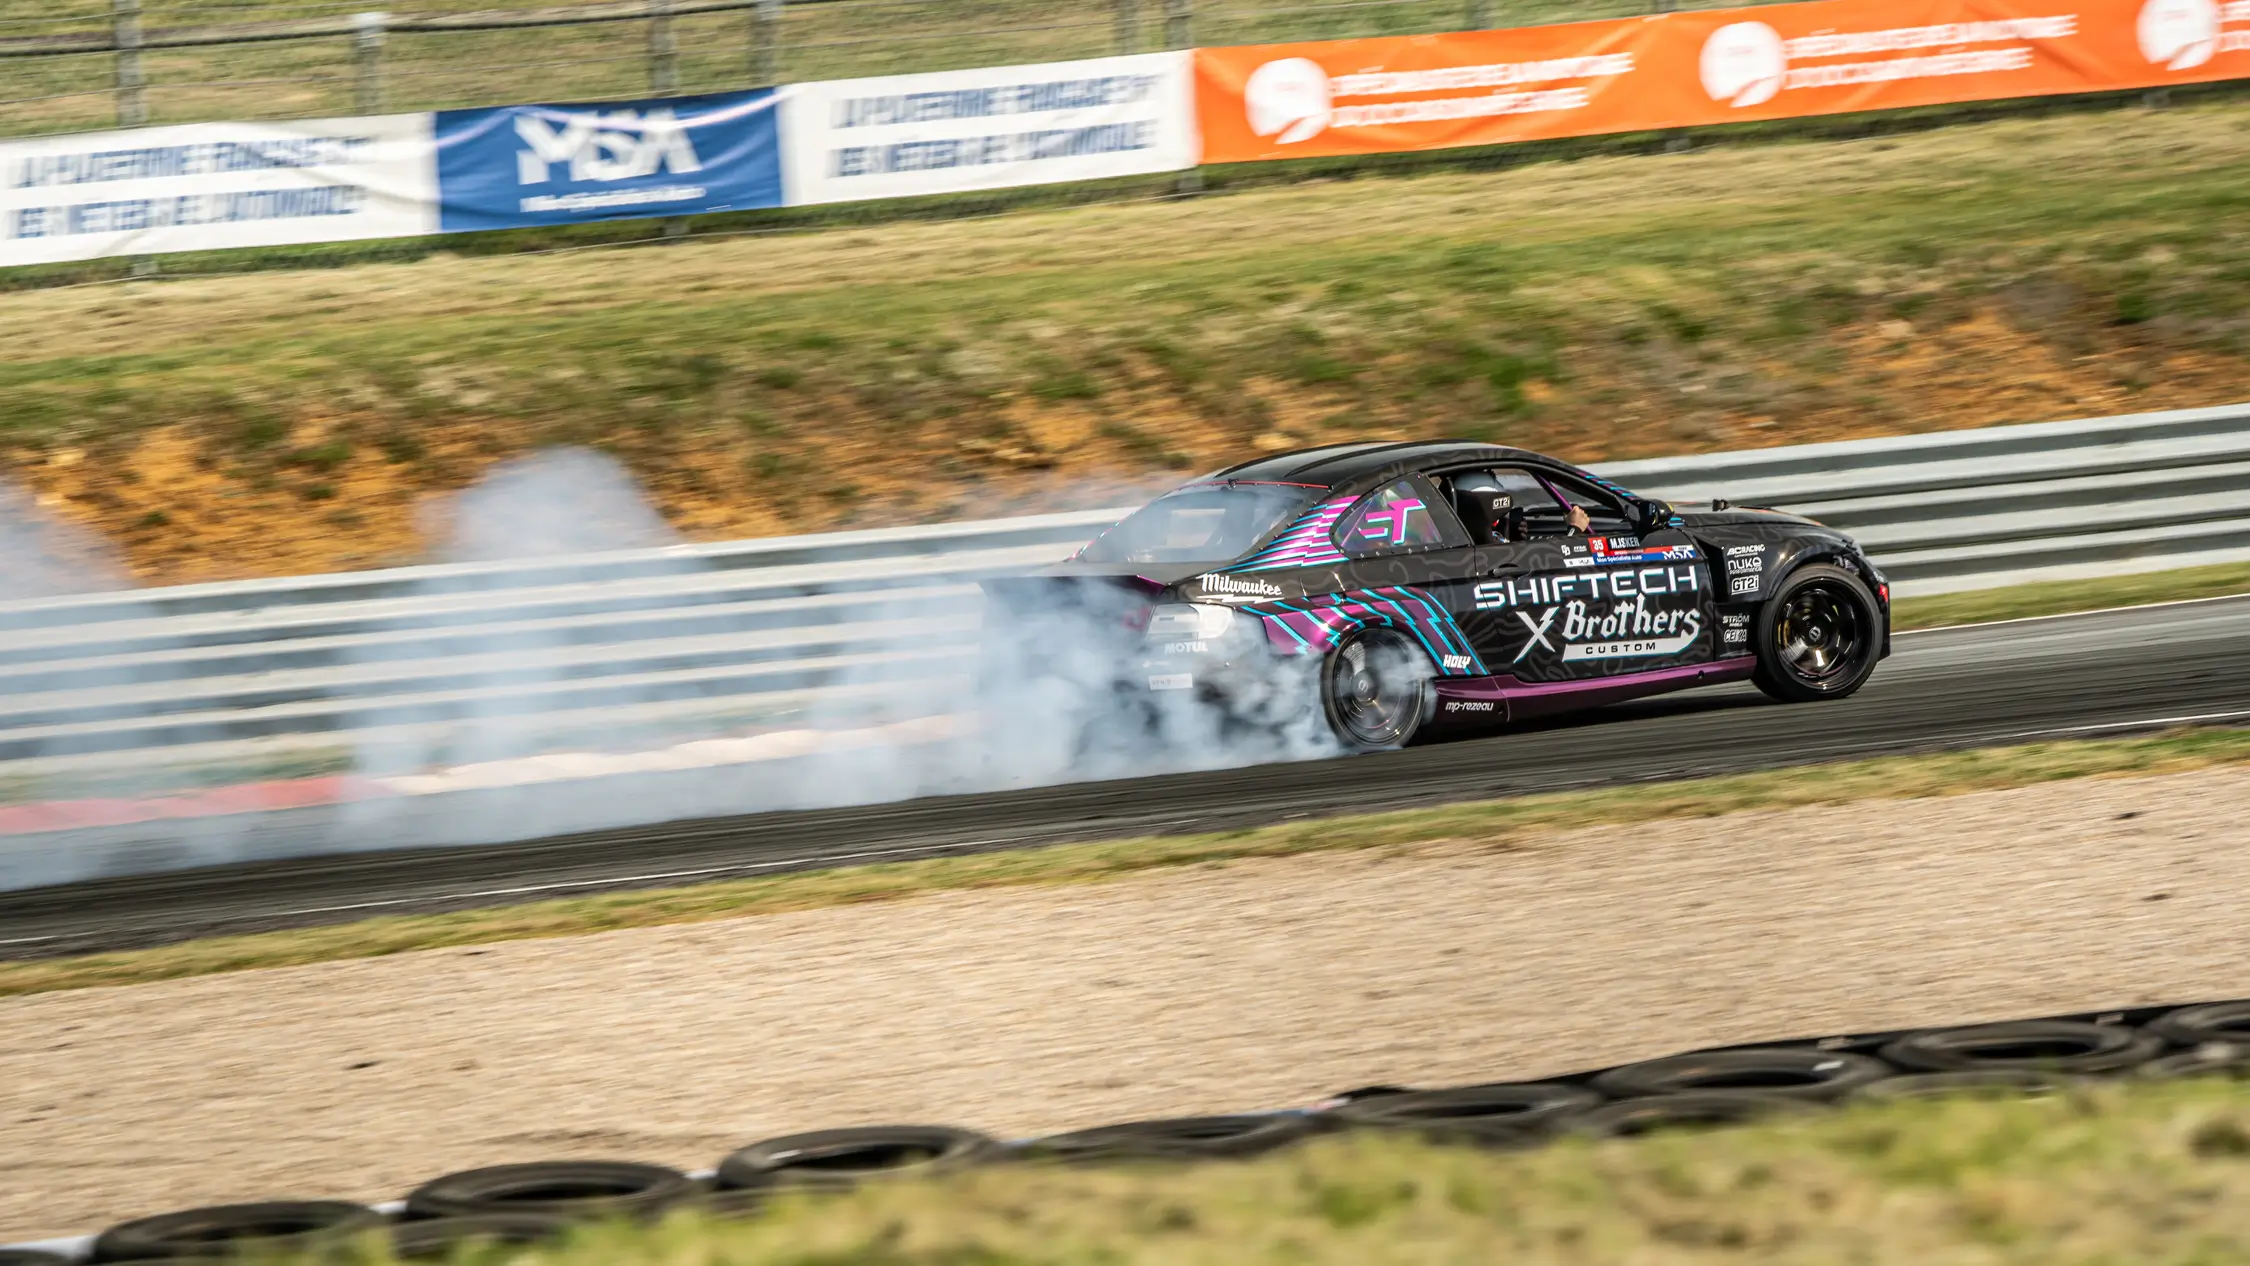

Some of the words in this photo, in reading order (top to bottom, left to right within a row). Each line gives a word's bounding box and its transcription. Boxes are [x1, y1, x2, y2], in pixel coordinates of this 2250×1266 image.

[1592, 539, 1604, 551] 35
[1662, 550, 1694, 560] MSA
[1728, 557, 1762, 570] nuke
[1196, 573, 1283, 596] Milwaukee
[1474, 565, 1699, 611] SHIFTECH
[1732, 575, 1759, 591] GT2i
[1722, 613, 1750, 624] STRÖM
[1513, 606, 1560, 664] X
[1562, 592, 1700, 641] Brothers
[1164, 641, 1208, 655] MOTUL
[1585, 642, 1656, 655] CUSTOM
[1443, 654, 1471, 669] HOLY
[1445, 701, 1494, 713] mp-rezeau
